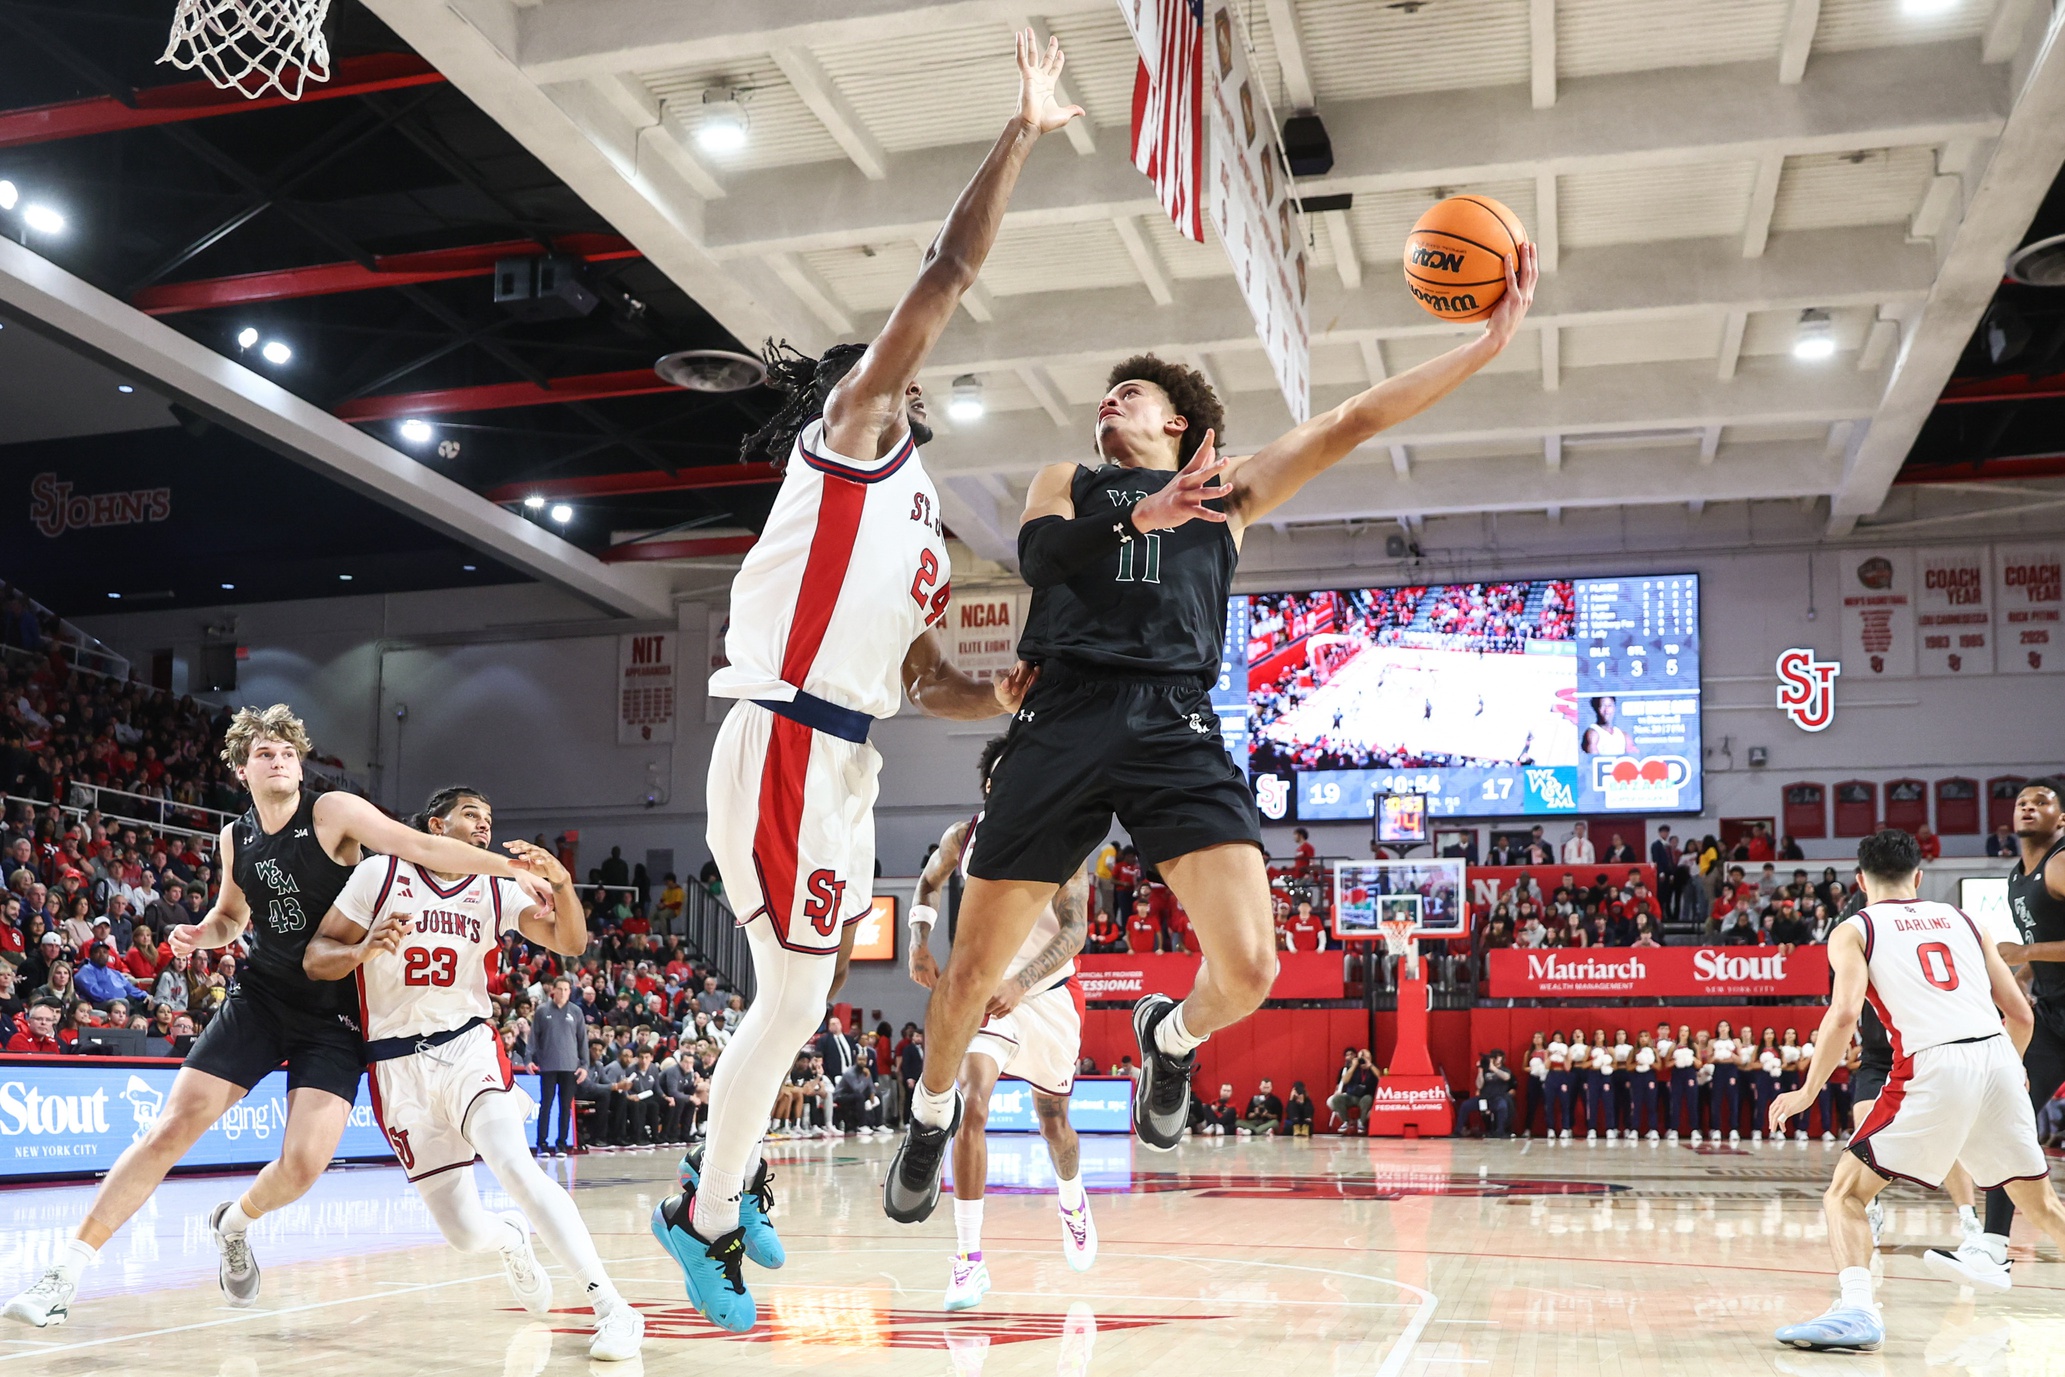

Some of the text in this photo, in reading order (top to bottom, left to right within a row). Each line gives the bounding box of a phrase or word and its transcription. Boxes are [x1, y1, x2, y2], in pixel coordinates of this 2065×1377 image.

[1412, 247, 1465, 273] NCAA
[1407, 279, 1480, 312] Wilson
[1115, 533, 1160, 583] 11
[910, 547, 951, 627] 24
[1925, 568, 1980, 589] COACH
[2005, 565, 2061, 586] COACH
[1947, 586, 1982, 605] YEAR
[2027, 584, 2062, 602] YEAR
[961, 603, 1010, 628] NCAA
[632, 636, 664, 664] NIT
[959, 640, 1011, 654] ELITE EIGHT
[1597, 661, 1606, 678] 1
[1631, 660, 1643, 677] 3
[1310, 783, 1341, 805] 19
[1382, 775, 1440, 794] 10:54
[1482, 778, 1514, 800] 17
[255, 858, 300, 896] W&M
[269, 897, 306, 933] 43
[415, 909, 480, 943] JOHN'S
[1895, 917, 1951, 931] DARLING
[404, 946, 458, 987] 23
[1528, 953, 1646, 980] Matriarch
[1693, 950, 1788, 981] Stout
[1916, 942, 1959, 991] 0
[1080, 979, 1143, 991] ESSIONAL
[1539, 982, 1634, 990] WEALTH MANAGEMENT
[1375, 1086, 1446, 1104] Maspeth
[0, 1081, 110, 1136] Stout
[15, 1144, 98, 1158] NEW YORK CITY
